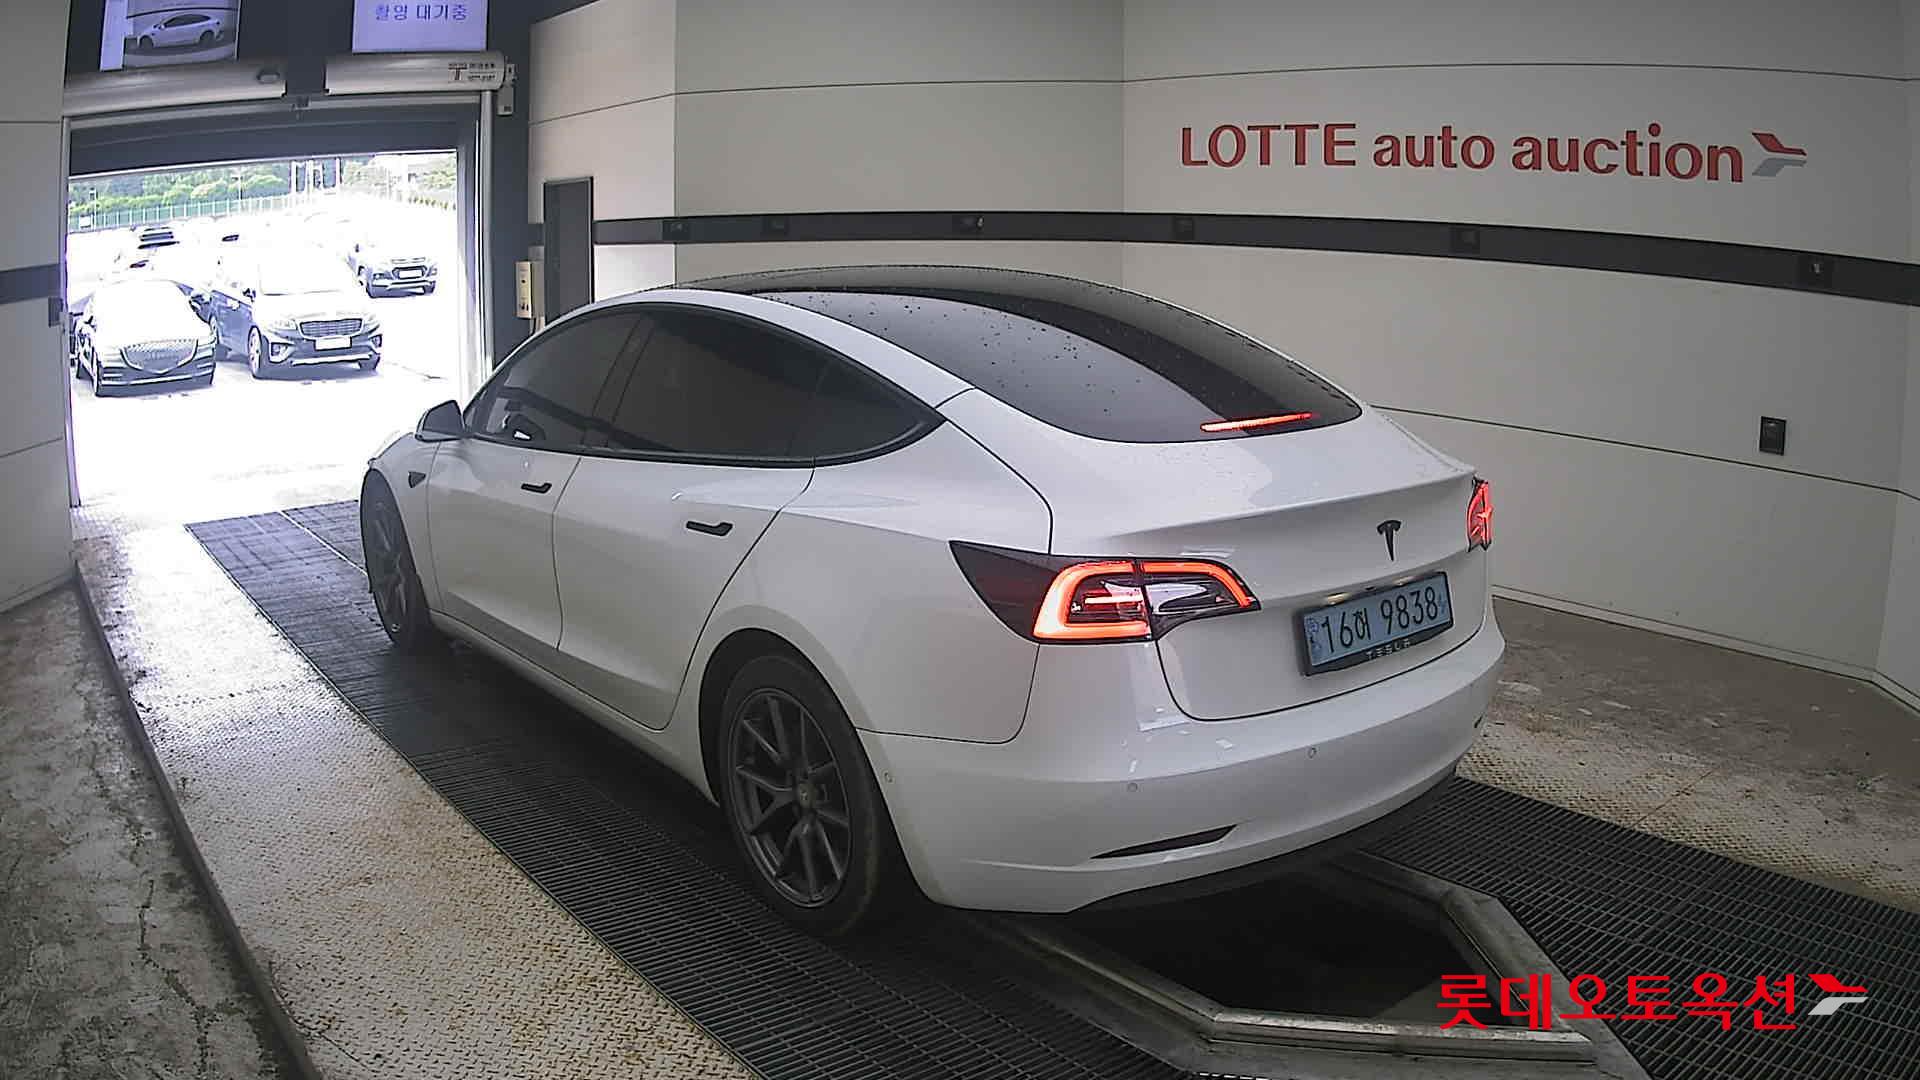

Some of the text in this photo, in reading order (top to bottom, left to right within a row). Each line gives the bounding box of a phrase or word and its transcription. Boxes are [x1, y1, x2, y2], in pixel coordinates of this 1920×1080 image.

[416, 4, 467, 21] 대기중
[1181, 123, 1744, 182] LOTTE auto auction
[1321, 586, 1438, 654] 16허 9838
